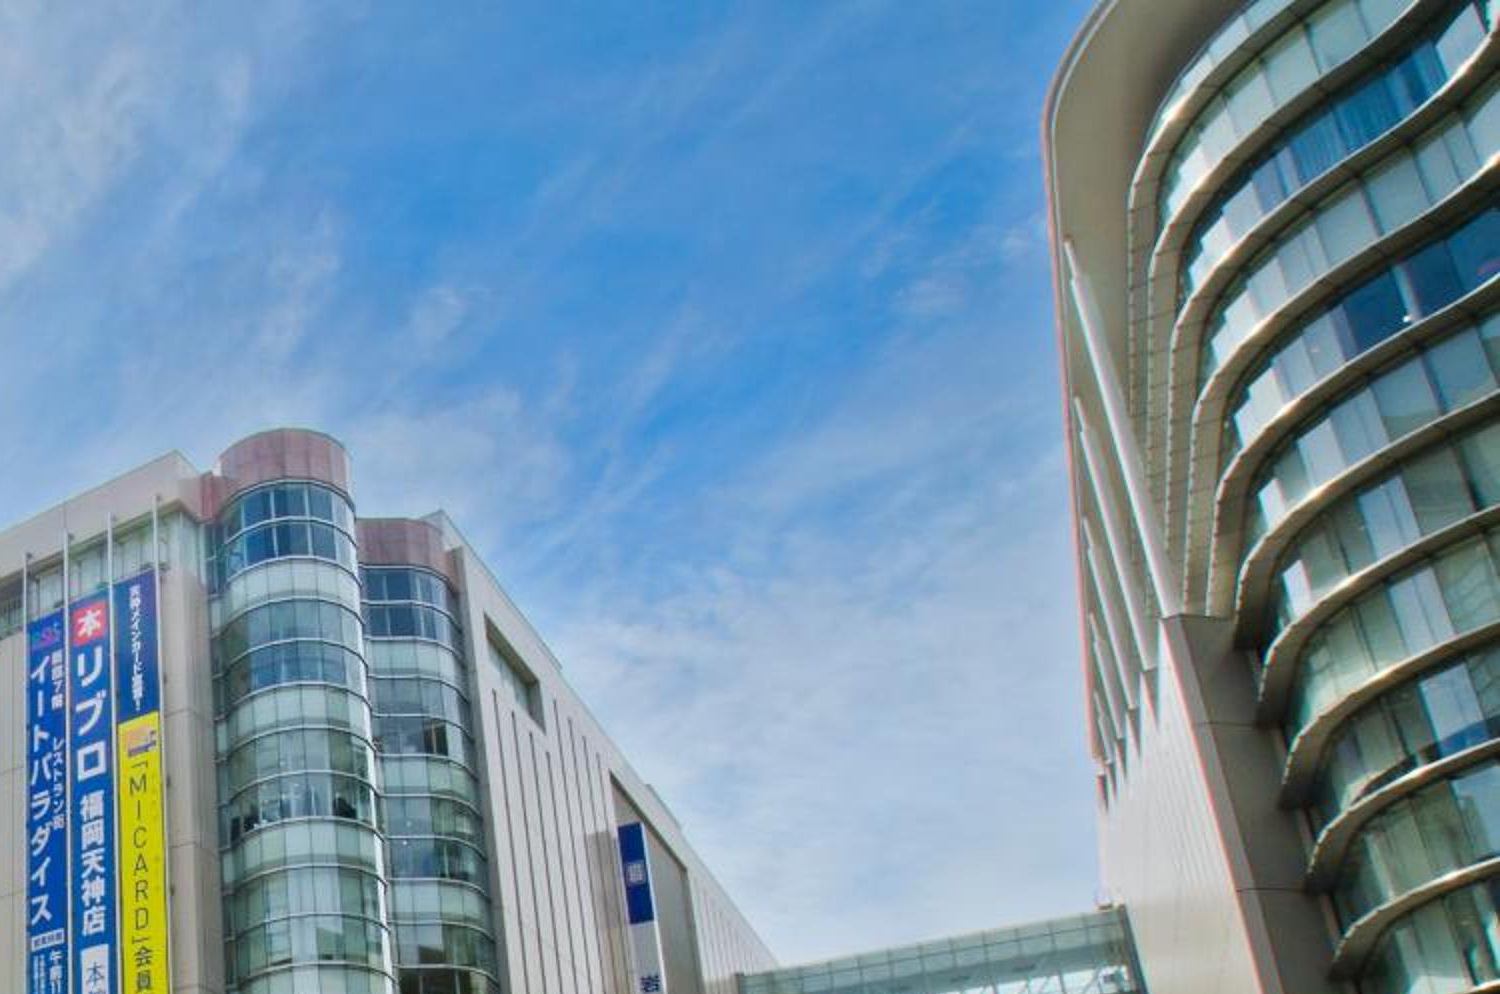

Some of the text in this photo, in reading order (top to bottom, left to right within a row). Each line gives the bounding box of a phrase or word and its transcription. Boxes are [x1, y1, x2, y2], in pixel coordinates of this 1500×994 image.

[77, 606, 102, 639] 本
[31, 655, 51, 926] イートパラダイス
[75, 645, 107, 937] リブロ 福岡天神店
